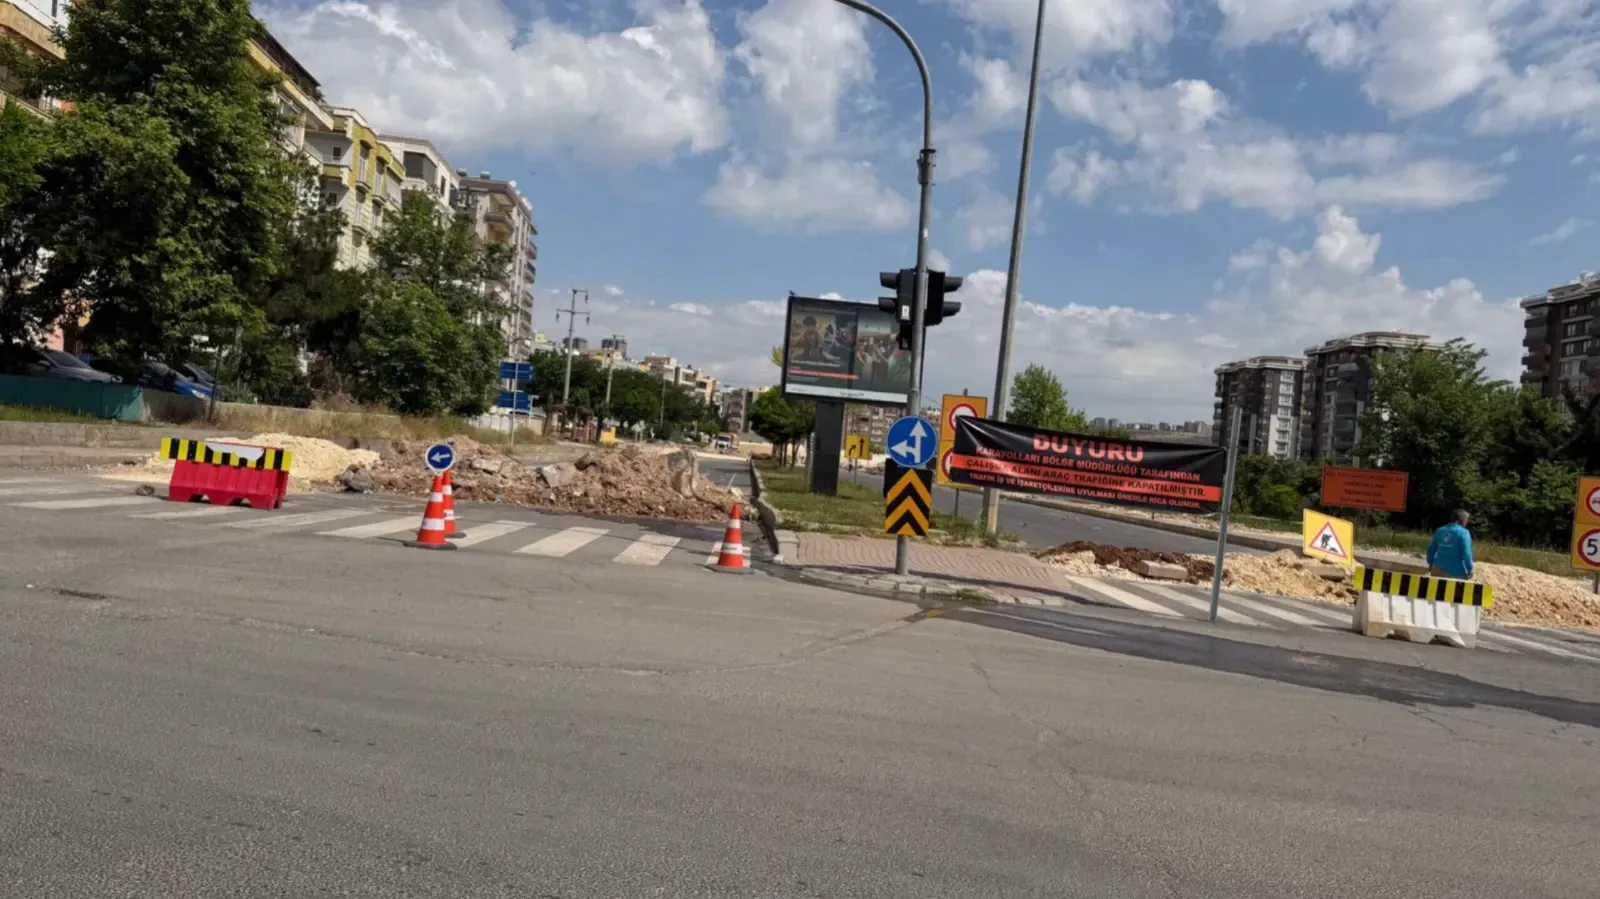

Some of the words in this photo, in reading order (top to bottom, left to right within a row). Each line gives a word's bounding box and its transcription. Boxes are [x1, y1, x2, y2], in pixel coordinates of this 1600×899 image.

[1032, 433, 1144, 462] DUYURU
[976, 446, 1040, 463] KARAYOLLARI
[1042, 455, 1074, 467] BÖLGE
[1076, 460, 1137, 476] MÜDÜRLÜĞÜ
[1140, 467, 1201, 481] TARAFINDAN
[1043, 468, 1069, 480] ARAÇ
[1073, 473, 1125, 487] TRAFİĞİNE
[1128, 481, 1206, 497] KAPATILMIŞTIR.
